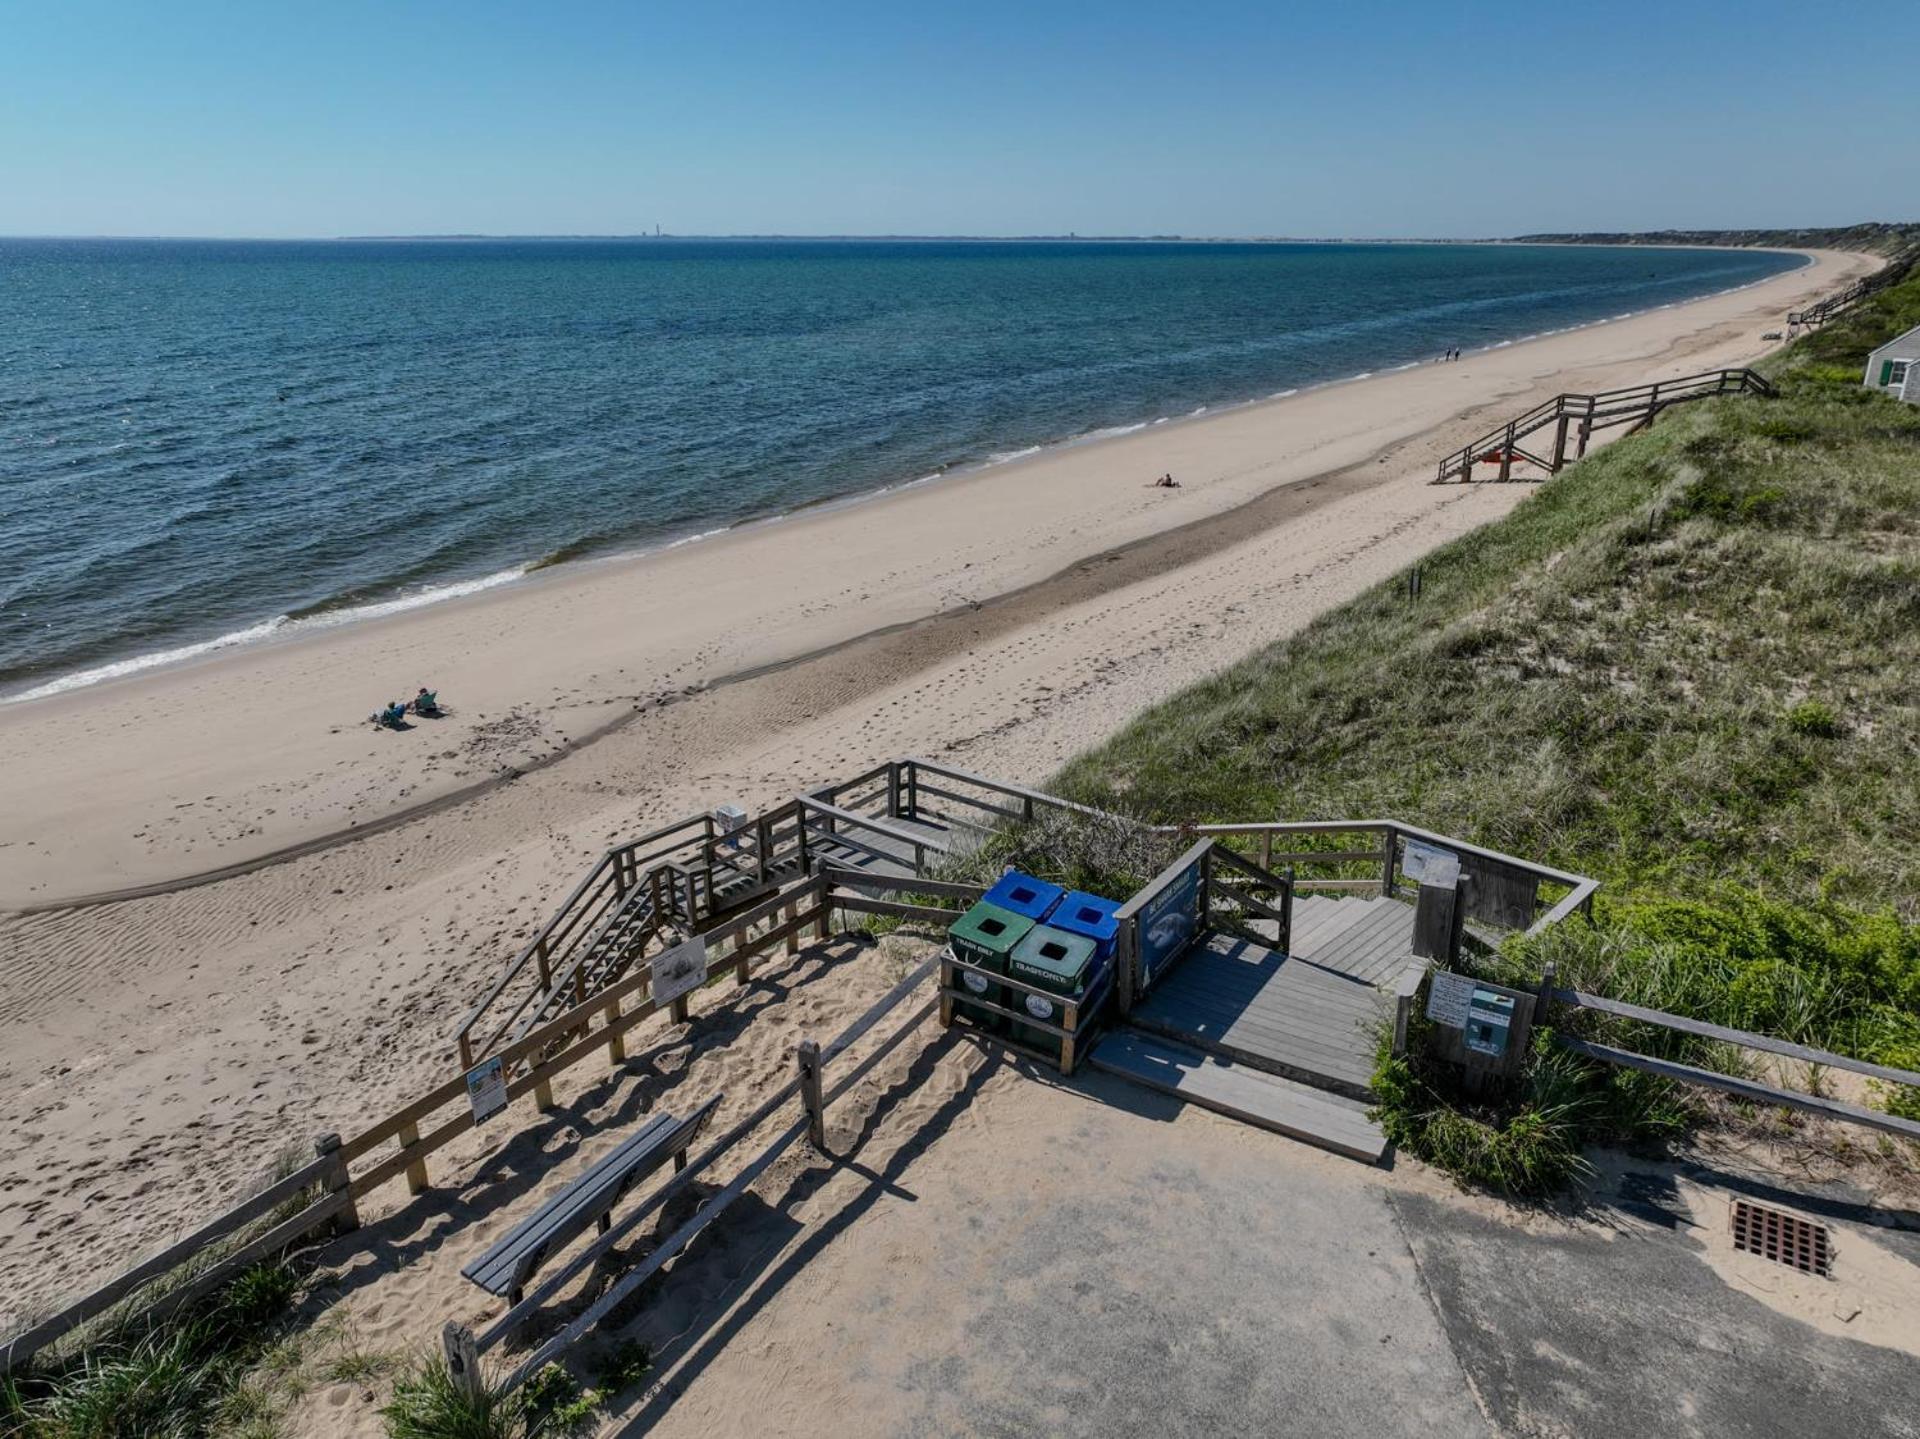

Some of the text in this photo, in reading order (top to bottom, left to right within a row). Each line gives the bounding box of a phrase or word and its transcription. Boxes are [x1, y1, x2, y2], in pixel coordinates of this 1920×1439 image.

[977, 946, 994, 957] ONLY
[1016, 962, 1065, 983] TRASH ONLY
